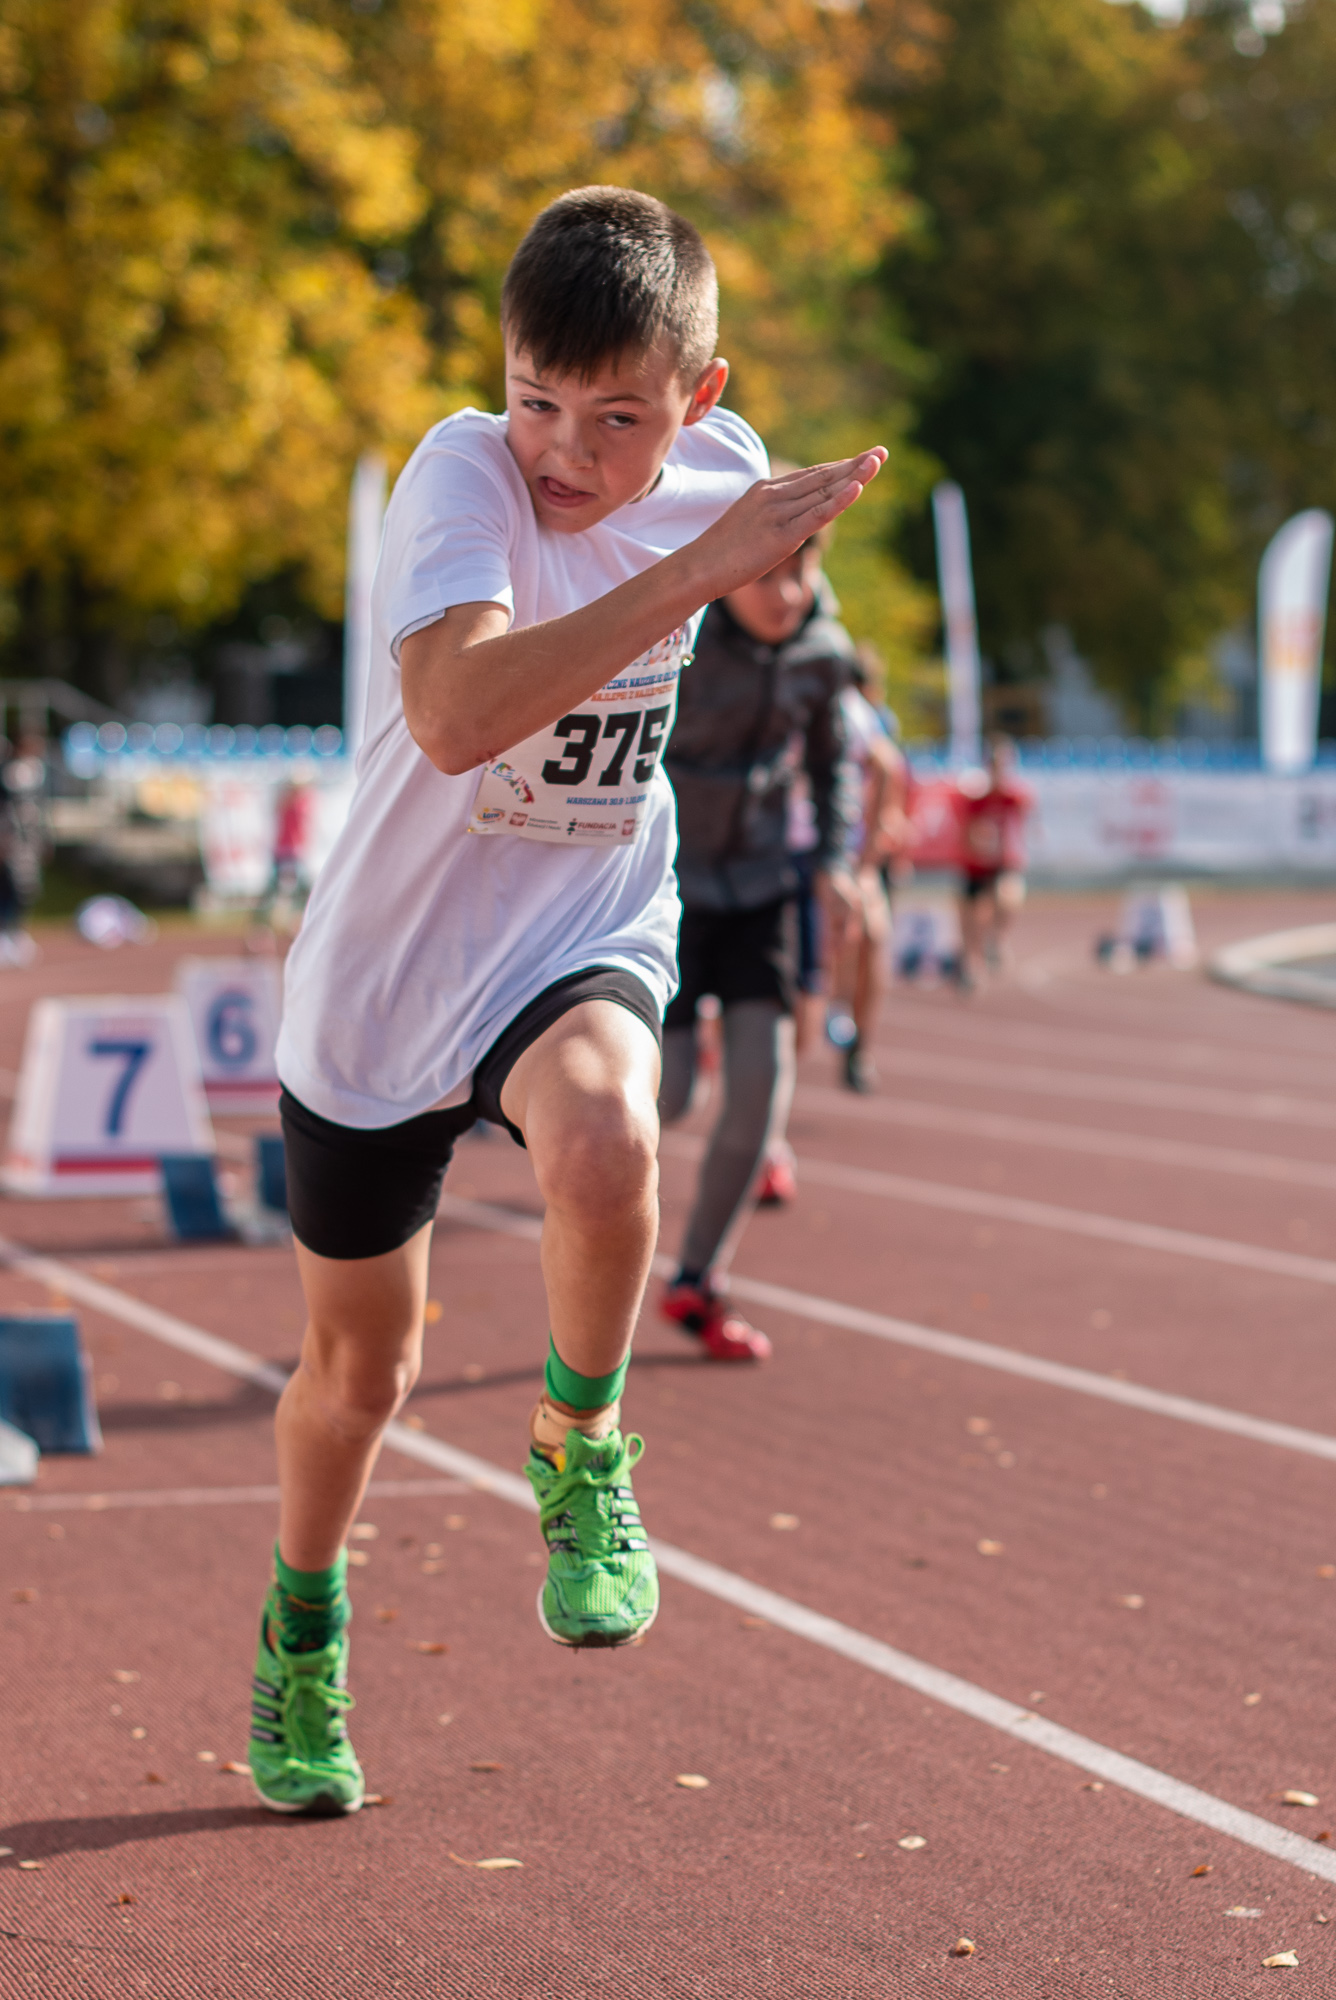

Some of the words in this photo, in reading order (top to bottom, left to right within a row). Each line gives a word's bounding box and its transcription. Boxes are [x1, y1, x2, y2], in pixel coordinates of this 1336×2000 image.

[602, 679, 628, 689] CZNE
[541, 703, 671, 787] 375
[566, 797, 608, 805] WARSZAWA
[578, 822, 617, 830] FUNDACJA
[206, 991, 258, 1073] 6
[88, 1040, 153, 1136] 7
